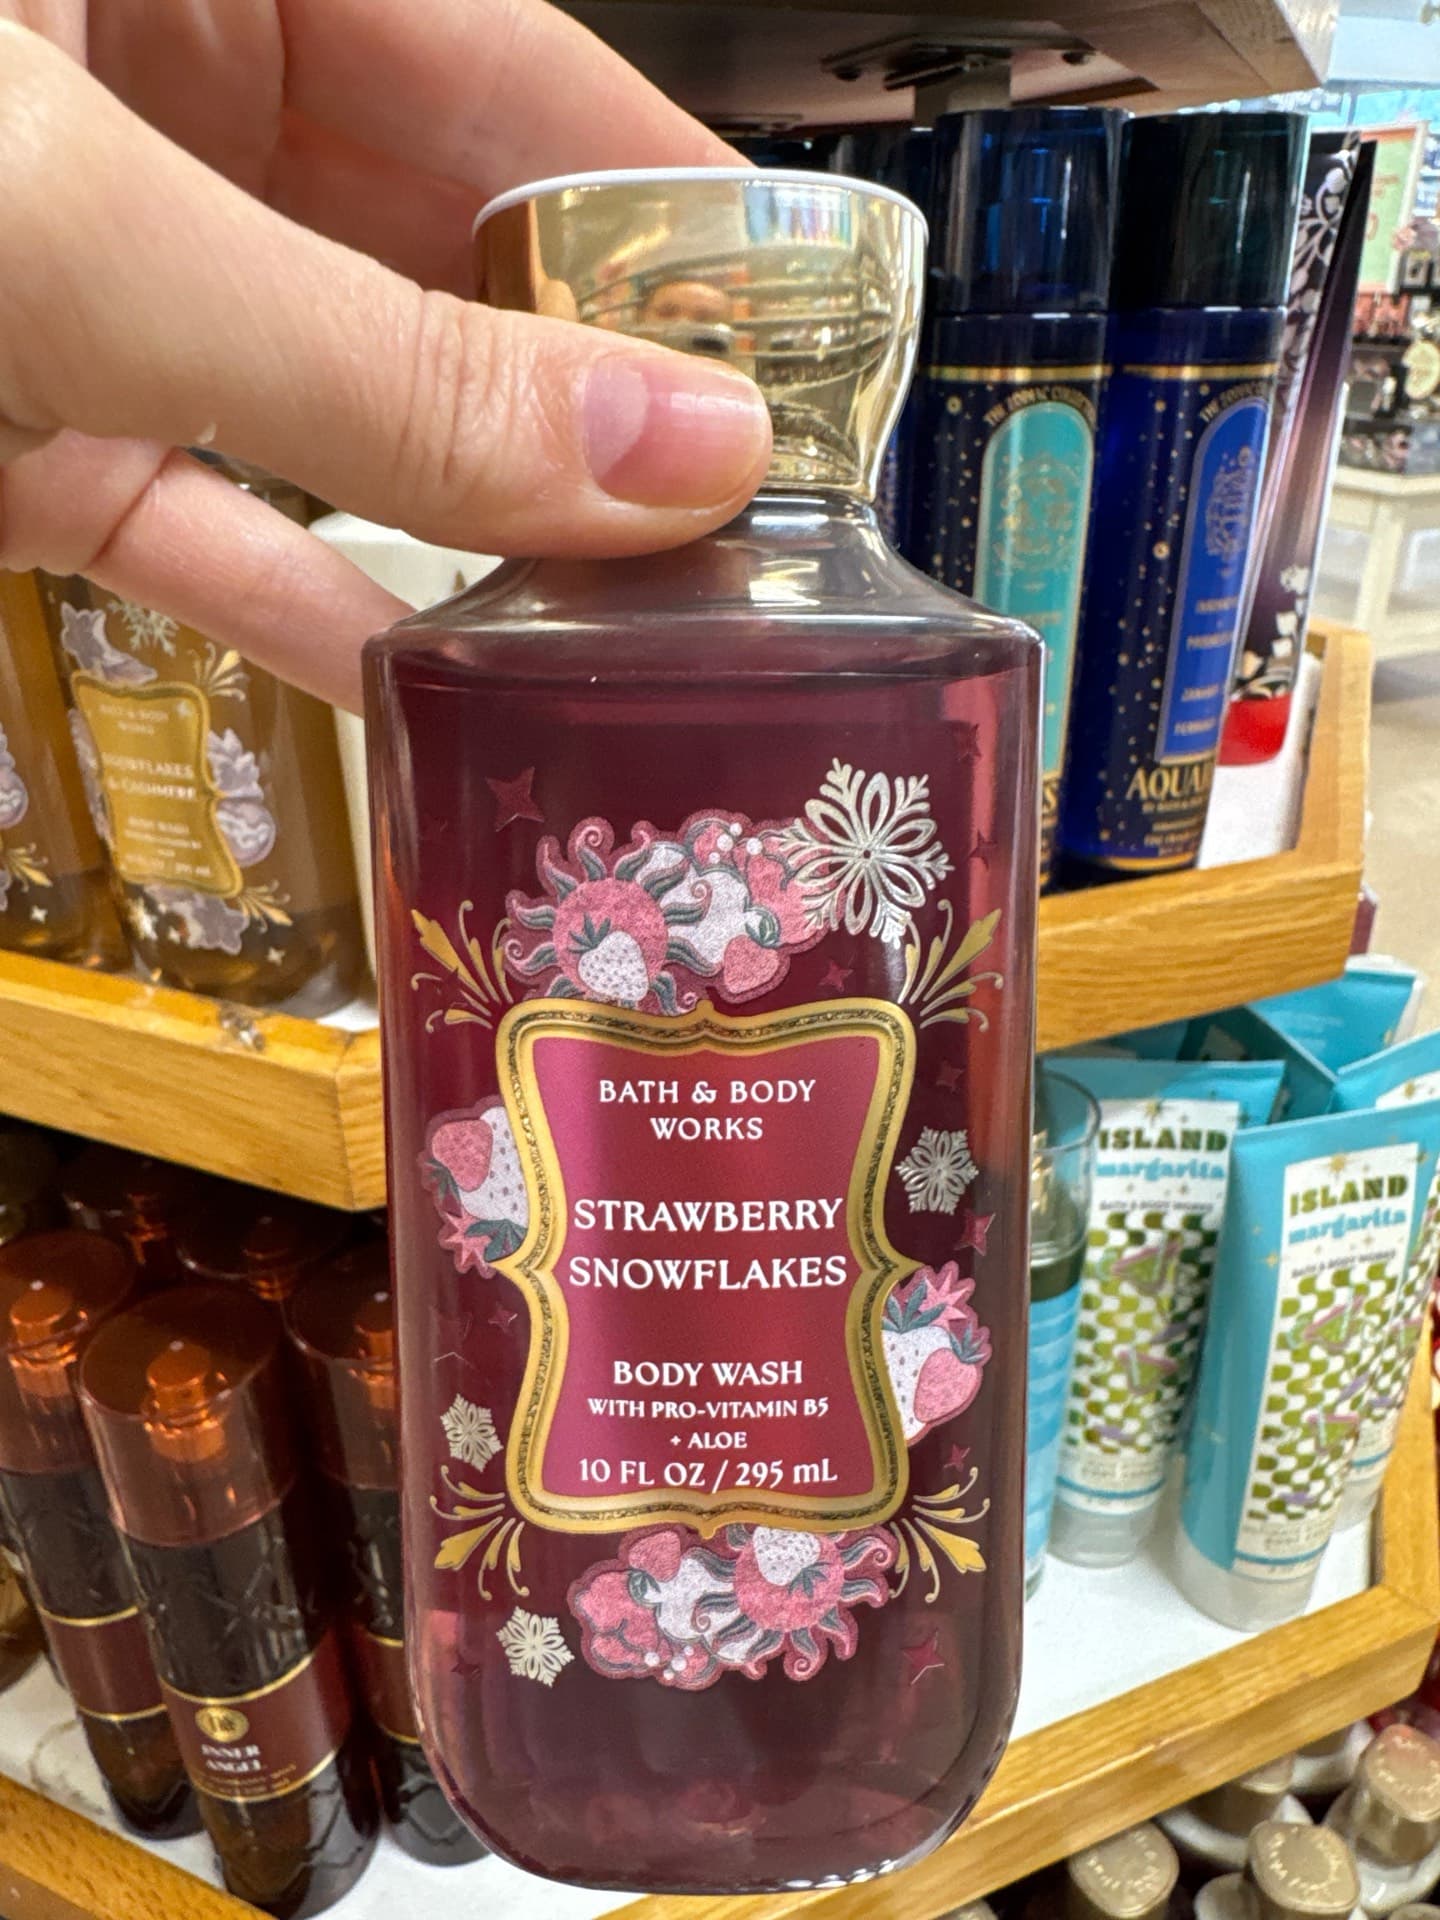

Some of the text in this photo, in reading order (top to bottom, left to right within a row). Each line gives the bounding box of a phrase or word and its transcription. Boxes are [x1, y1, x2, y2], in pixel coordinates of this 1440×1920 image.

[599, 1079, 816, 1104] BATH & BODY
[649, 1116, 763, 1141] WORKS
[1098, 1127, 1228, 1152] ISLAND
[1096, 1157, 1226, 1182] margarita
[1289, 1174, 1408, 1218] ISLAND
[573, 1198, 844, 1232] STRAWBERRY
[1288, 1207, 1407, 1245] margarita
[568, 1255, 847, 1290] SNOWFLAKES
[613, 1360, 803, 1387] BODY WASH
[587, 1396, 829, 1419] WITH PRO-VITAMIN B5
[687, 1431, 748, 1449] ALOE
[579, 1458, 838, 1494] 10 FL OZ / 295 mL
